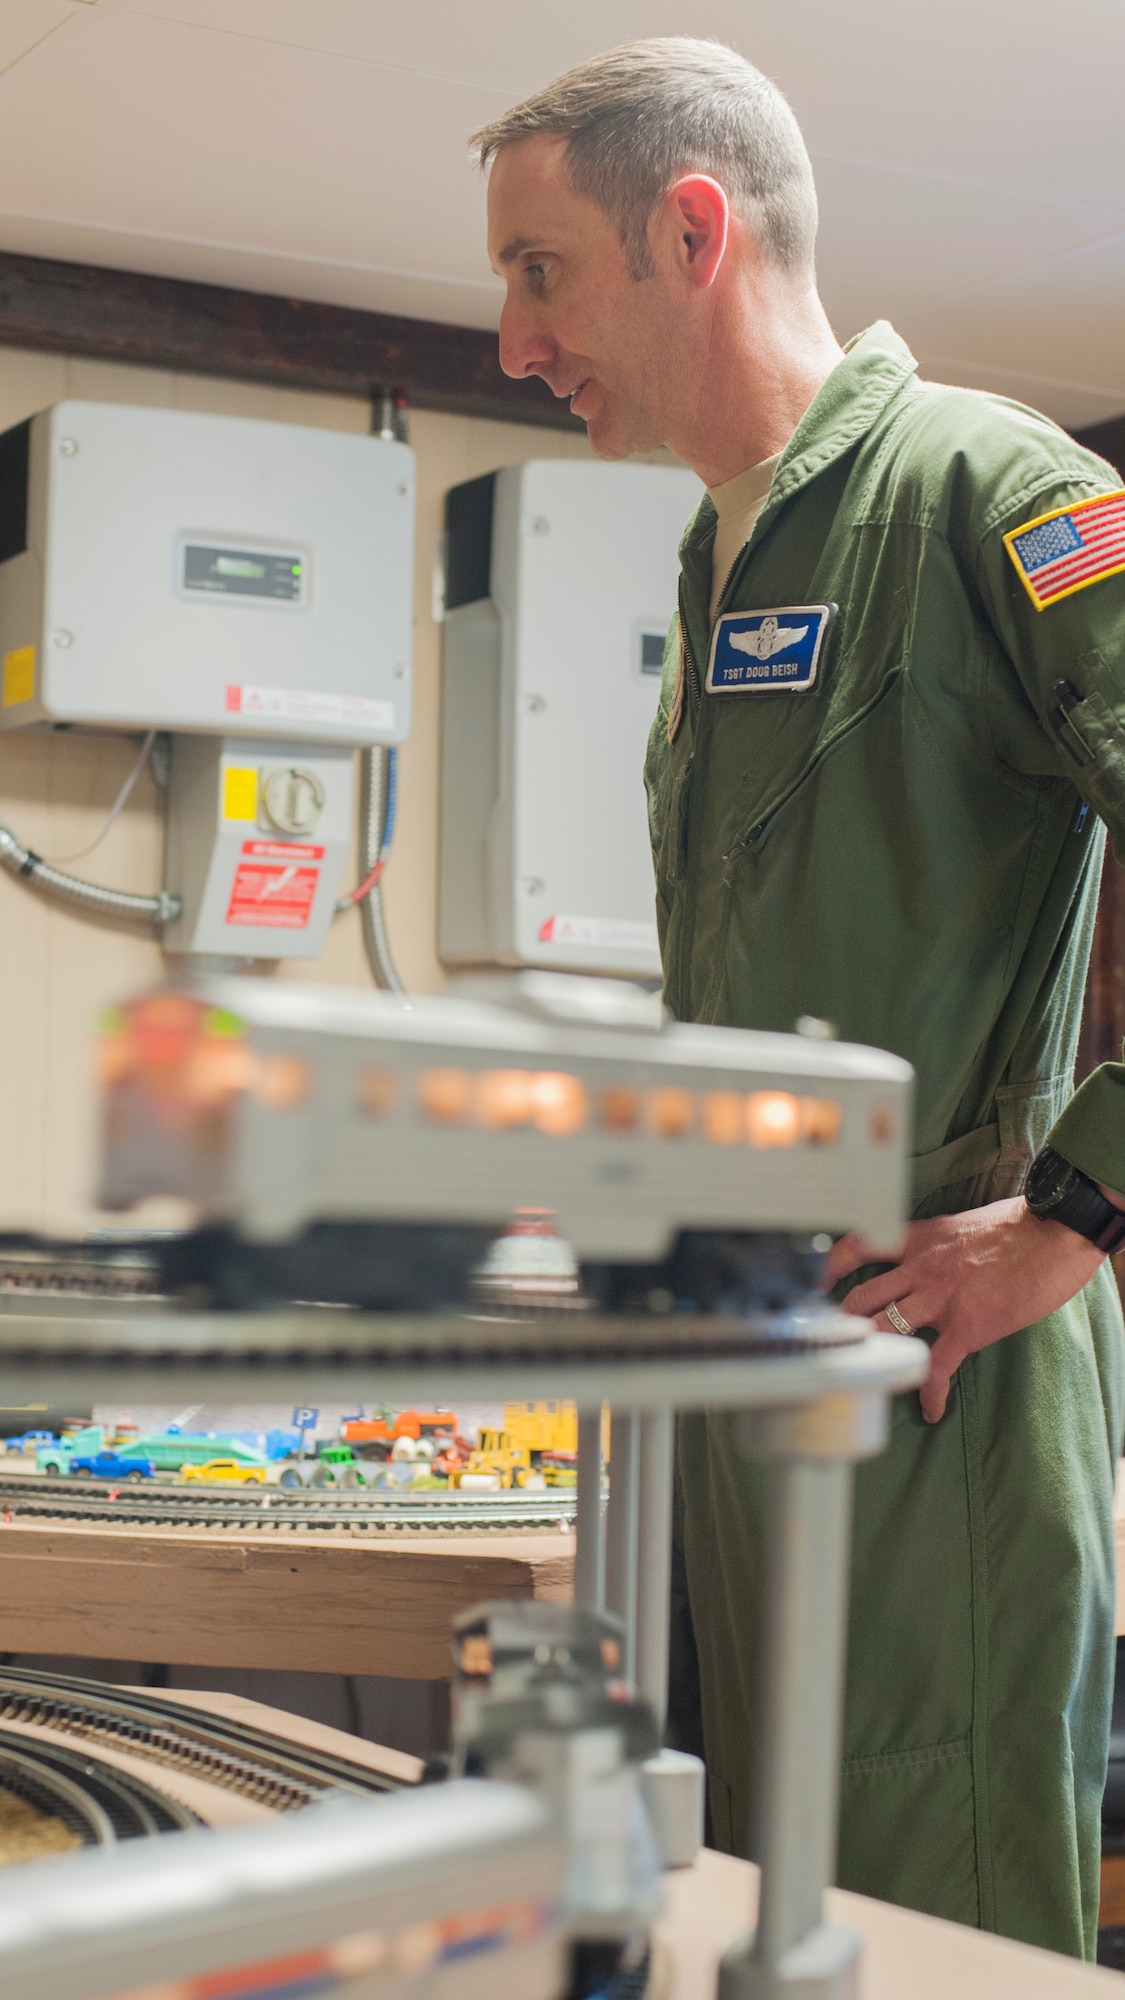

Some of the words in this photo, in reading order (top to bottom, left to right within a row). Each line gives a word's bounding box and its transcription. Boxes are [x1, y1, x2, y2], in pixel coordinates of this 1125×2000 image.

[723, 668, 744, 680] TSGT
[746, 666, 770, 678] DOUG
[772, 664, 798, 676] BEISH
[296, 1409, 313, 1426] P
